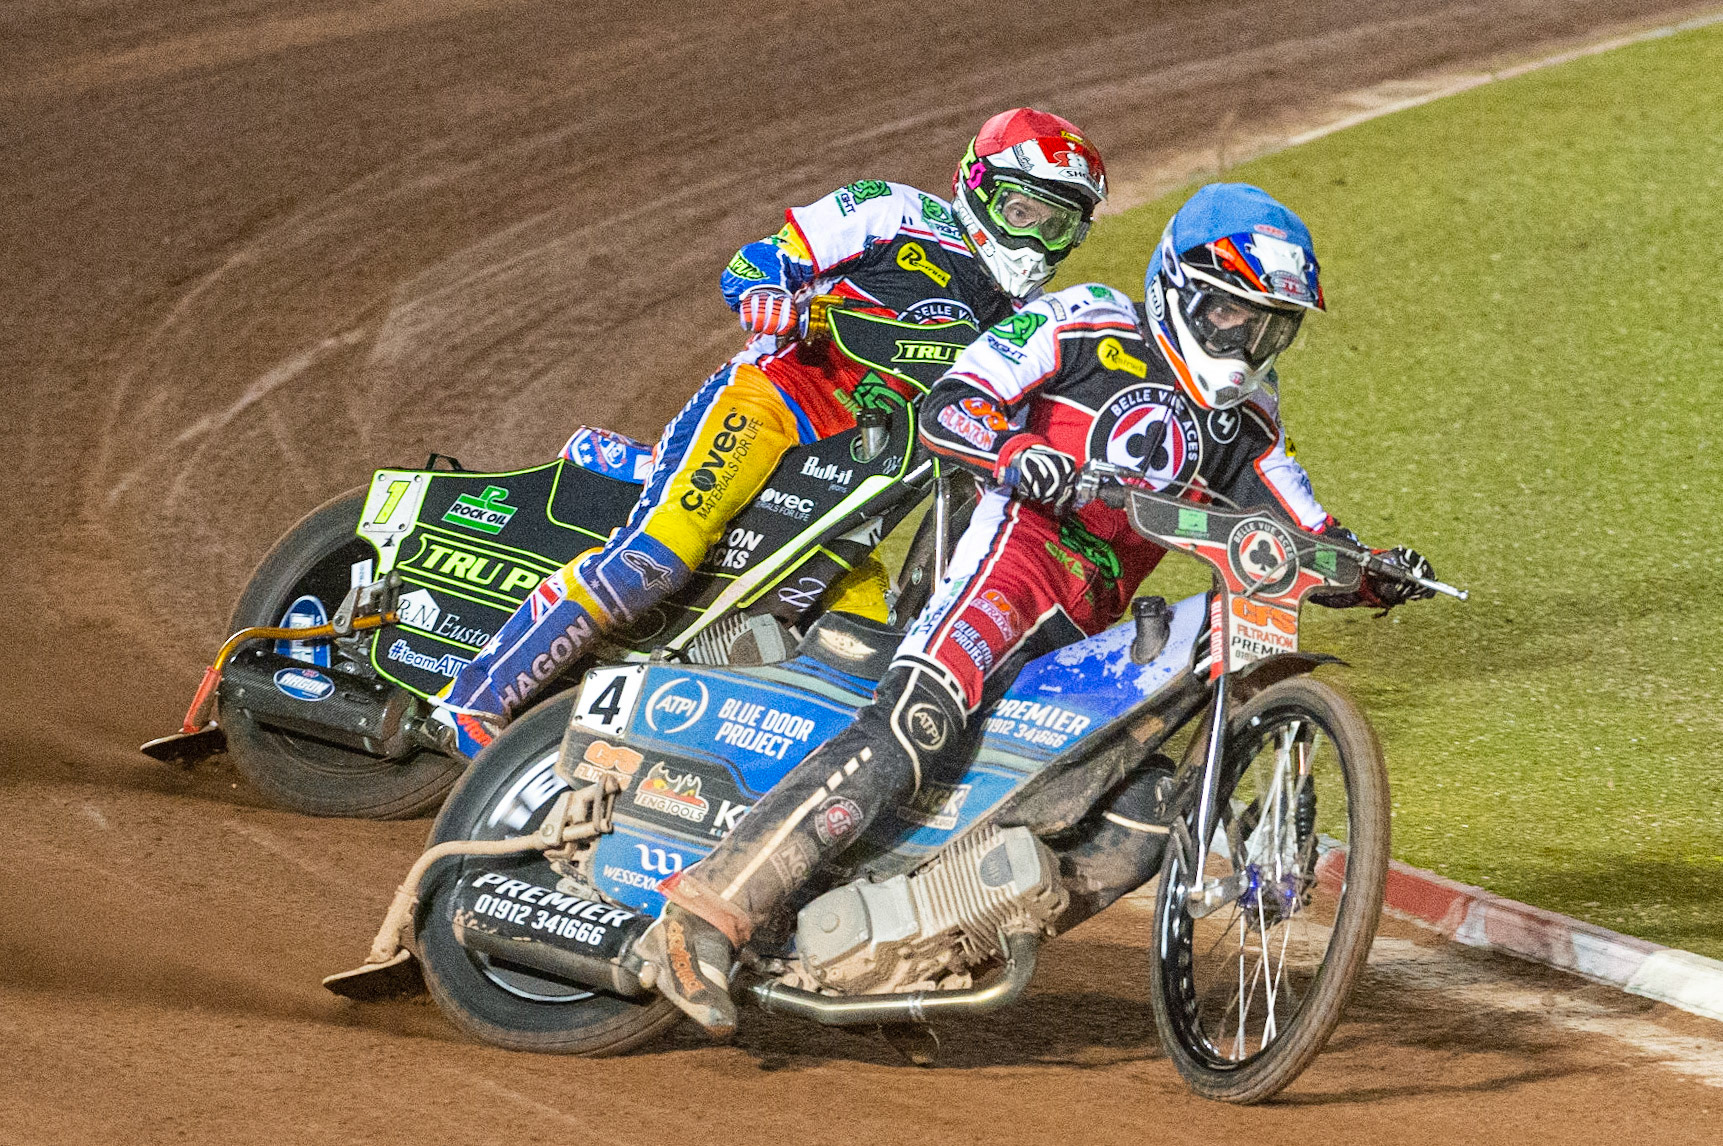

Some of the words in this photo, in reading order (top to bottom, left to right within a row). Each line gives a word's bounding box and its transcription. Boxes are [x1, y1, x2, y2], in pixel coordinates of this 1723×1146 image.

[904, 344, 952, 360] TRU
[1110, 388, 1152, 417] BELLE
[1182, 420, 1199, 461] ACES
[1217, 411, 1235, 435] 4
[697, 461, 739, 520] MATERIALS
[732, 439, 752, 463] FOR
[744, 417, 764, 440] LIFE
[800, 456, 853, 485] Bull-it
[373, 481, 411, 524] 1
[450, 503, 487, 519] ROCK
[486, 513, 508, 525] OIL
[1233, 524, 1256, 544] BELLE
[1259, 522, 1278, 536] VUE
[422, 544, 504, 585] TRU
[953, 620, 981, 641] BLUE
[1237, 624, 1293, 648] FILTRATION
[499, 615, 592, 715] HAGON
[279, 672, 331, 697] HAGON
[588, 675, 628, 725] 4
[655, 694, 698, 717] ATPI
[718, 698, 764, 725] BLUE
[760, 708, 815, 742] DOOR
[714, 720, 794, 760] PROJECT
[914, 711, 941, 746] ATPI
[1013, 723, 1068, 748] 341666
[472, 872, 636, 928] PREMIER
[474, 894, 533, 926] 01912
[531, 909, 607, 946] 341666
